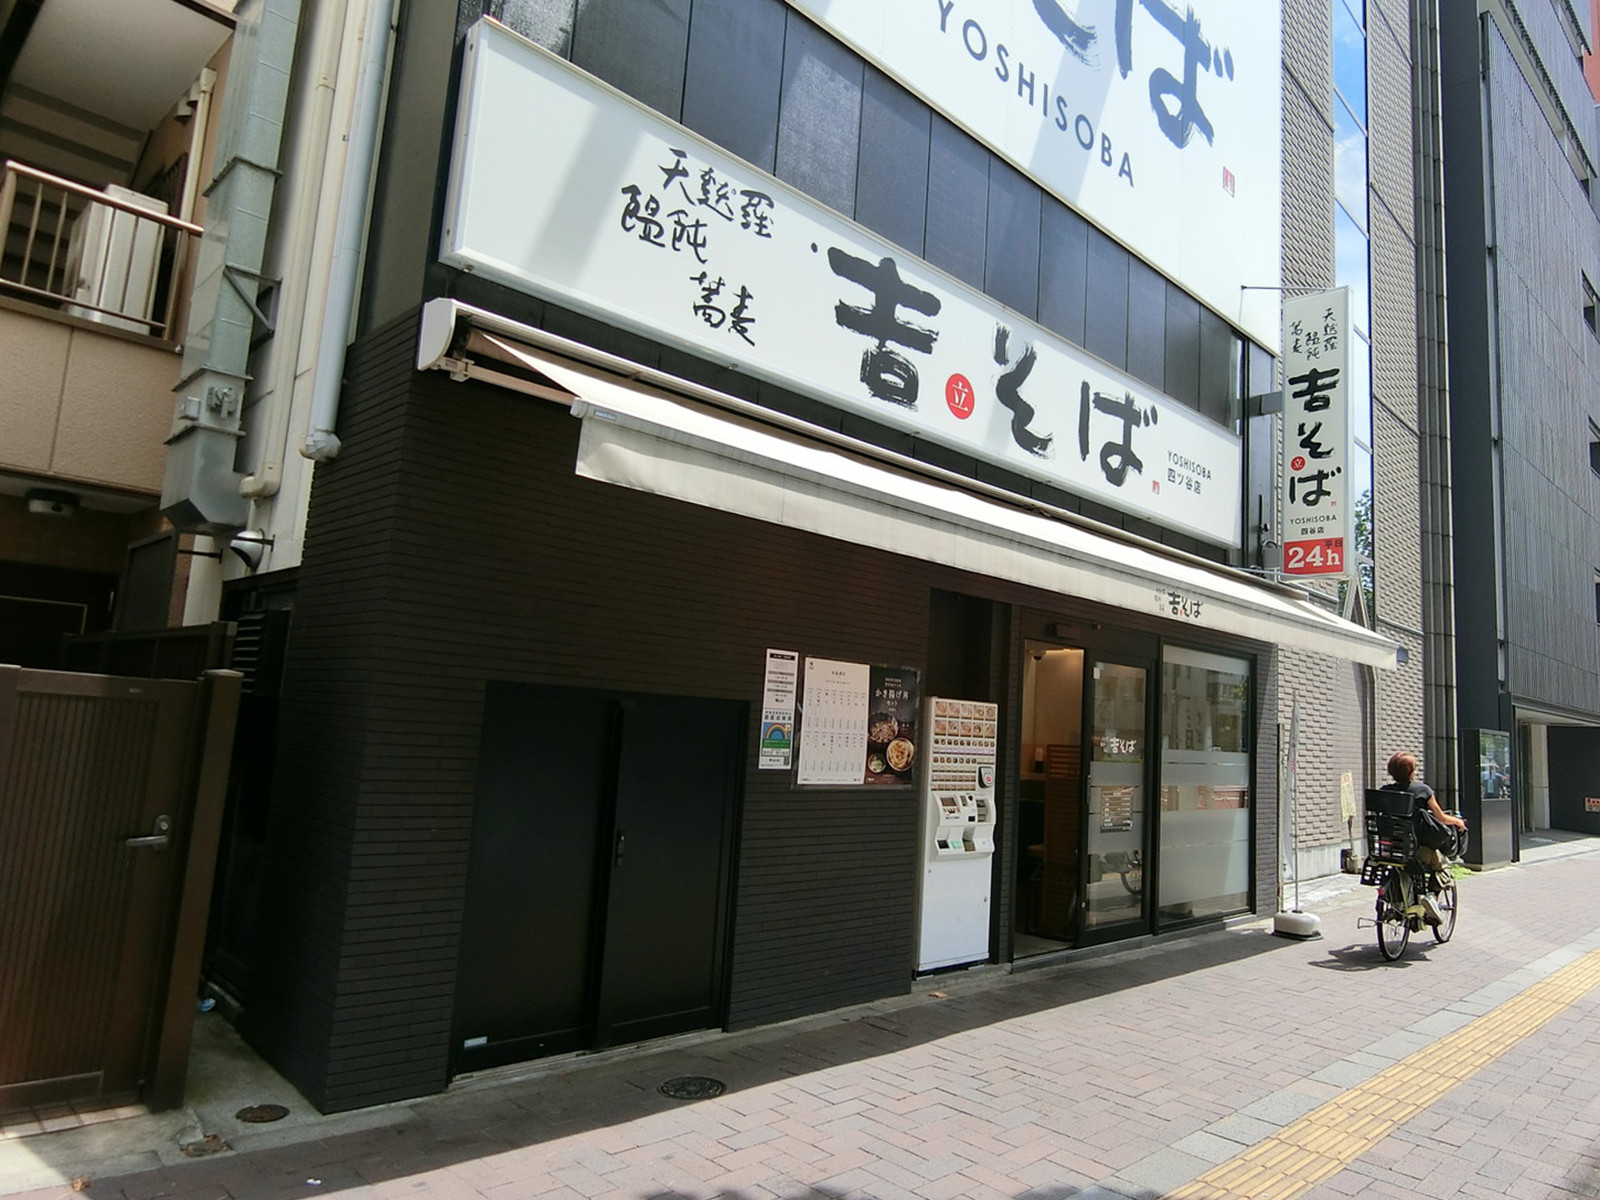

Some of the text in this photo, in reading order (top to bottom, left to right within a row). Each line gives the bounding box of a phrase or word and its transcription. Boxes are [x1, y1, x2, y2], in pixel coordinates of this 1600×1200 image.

[937, 0, 1134, 187] YOSHISOBA
[690, 271, 757, 347] 蕎麦
[948, 377, 972, 415] 立
[1167, 450, 1212, 481] YOSHISOBA
[1290, 514, 1337, 525] YOSHISOBA
[1288, 545, 1340, 569] 24h
[1167, 591, 1204, 618] 吉そば
[1109, 736, 1137, 754] 吉そば
